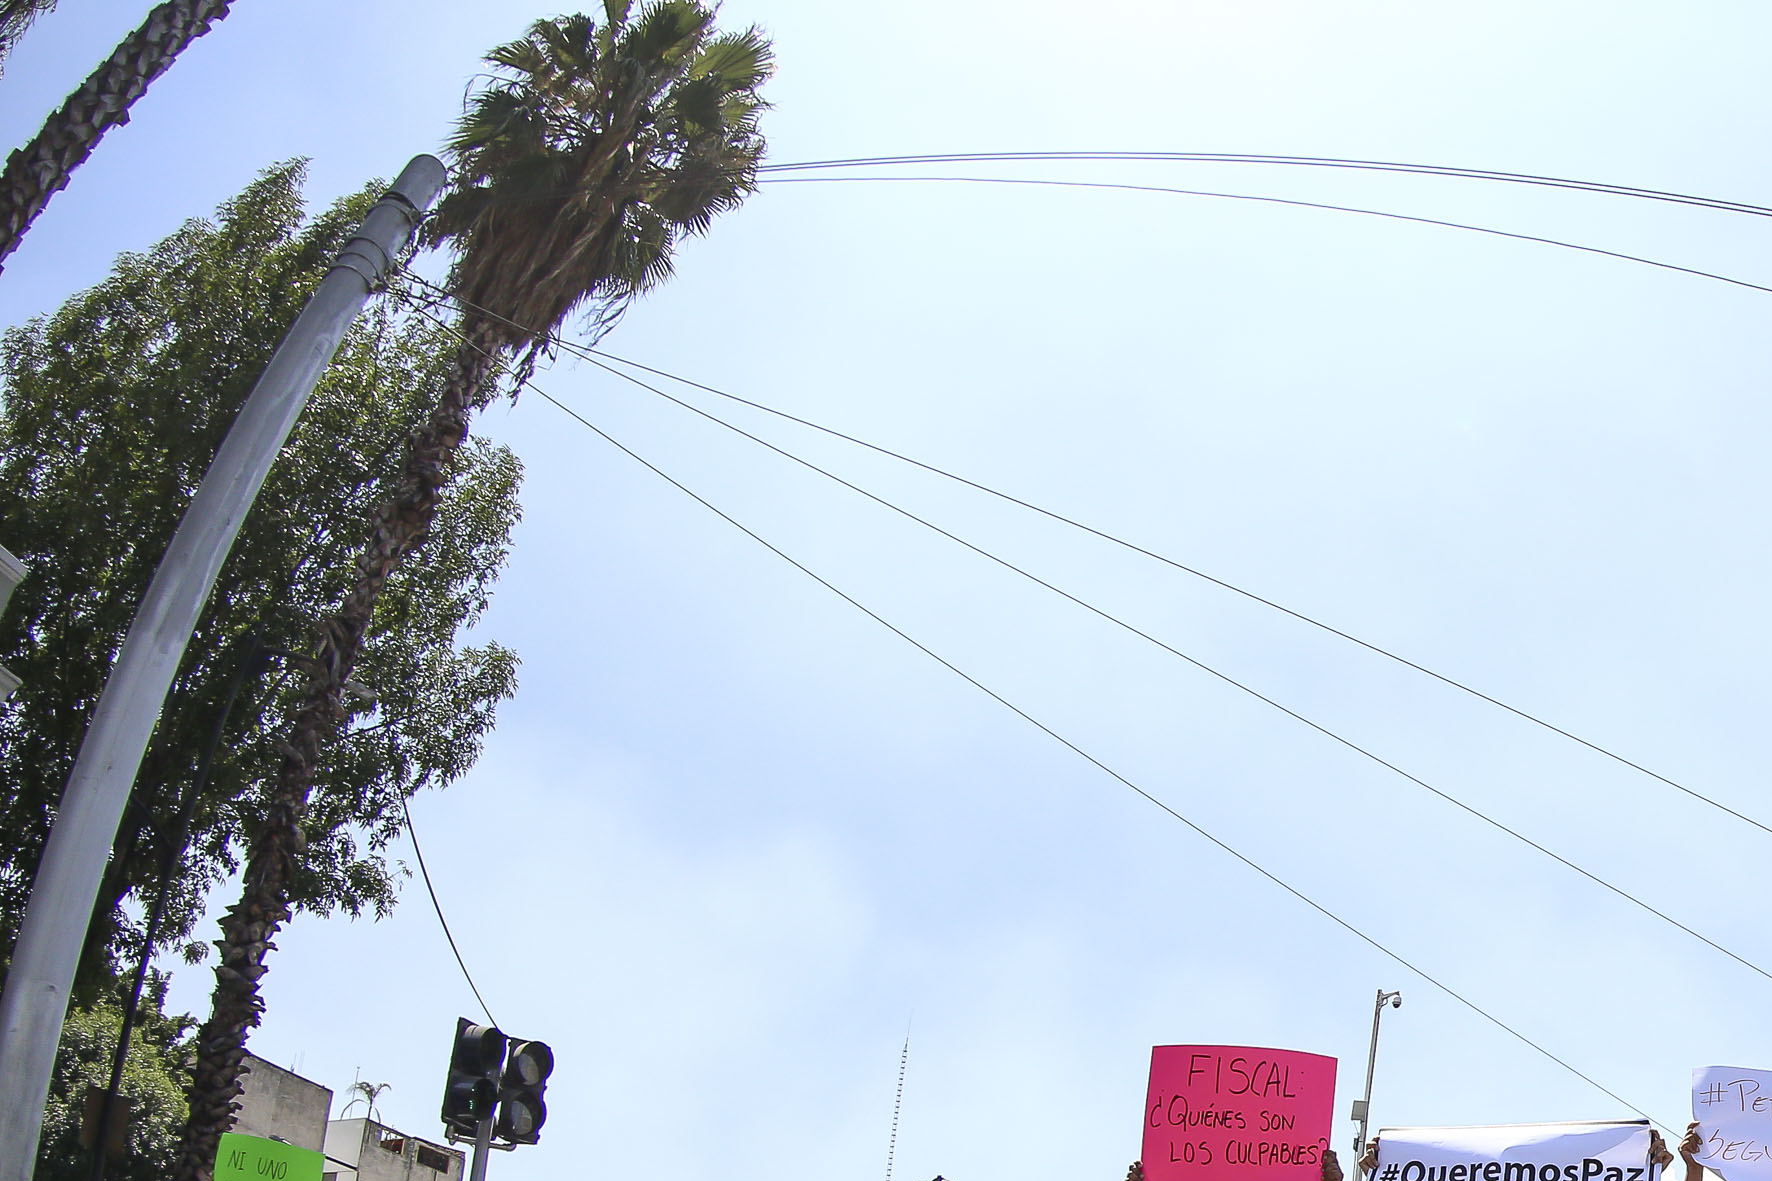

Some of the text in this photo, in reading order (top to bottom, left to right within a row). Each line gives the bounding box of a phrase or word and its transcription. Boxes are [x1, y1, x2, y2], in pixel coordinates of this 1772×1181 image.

[1259, 1110, 1295, 1132] SON
[227, 1149, 288, 1180] NI UNO
[1169, 1140, 1213, 1165] LOS
